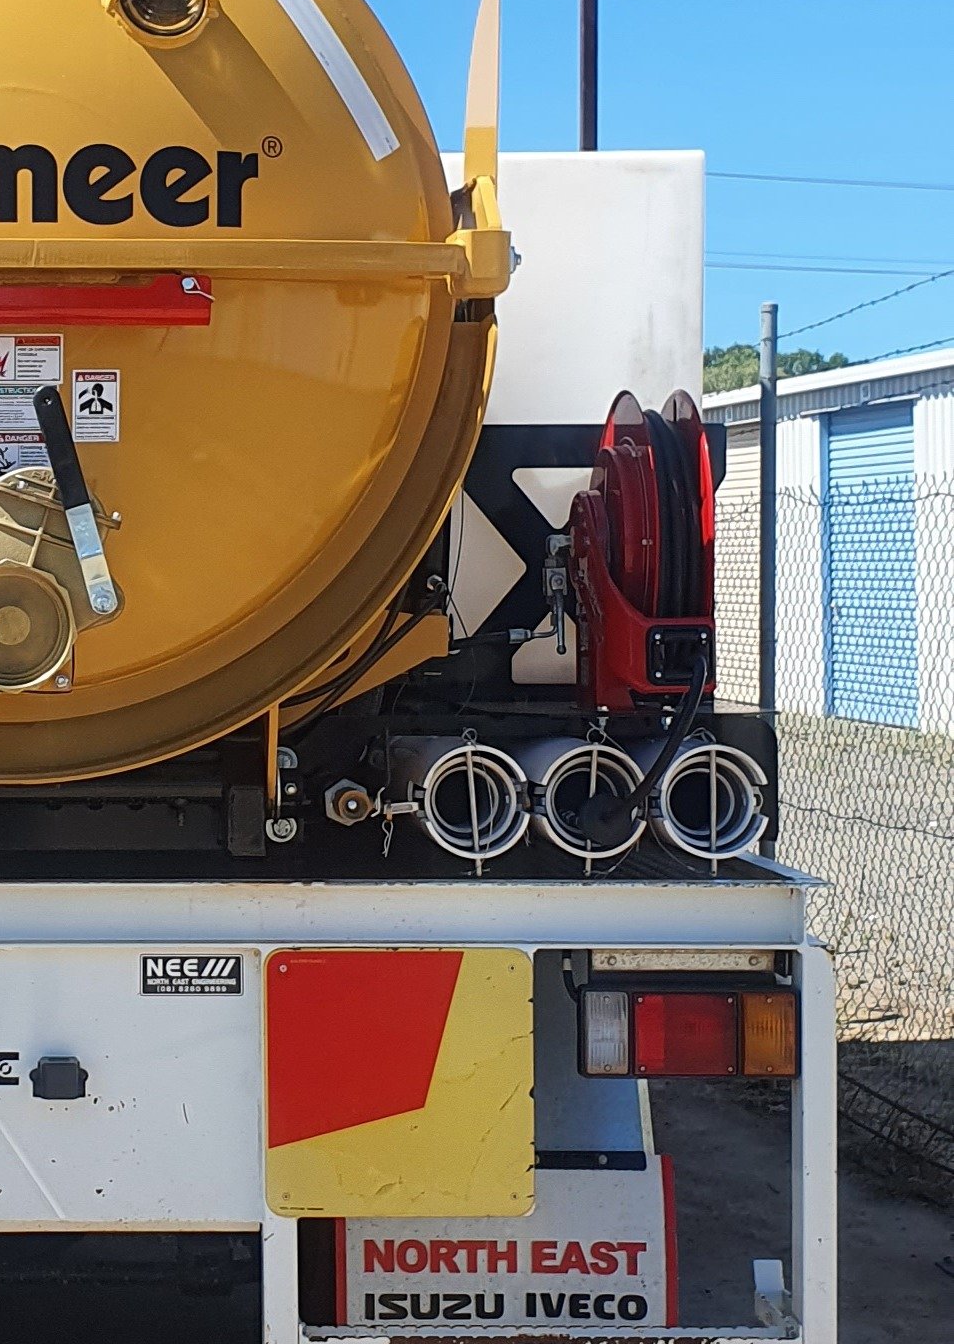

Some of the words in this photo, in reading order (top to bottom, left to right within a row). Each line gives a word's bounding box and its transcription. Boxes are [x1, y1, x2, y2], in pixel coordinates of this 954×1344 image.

[363, 1239, 518, 1274] NORTH
[531, 1240, 647, 1275] EAST
[364, 1292, 505, 1321] ISUZU
[525, 1292, 648, 1321] IVECO
